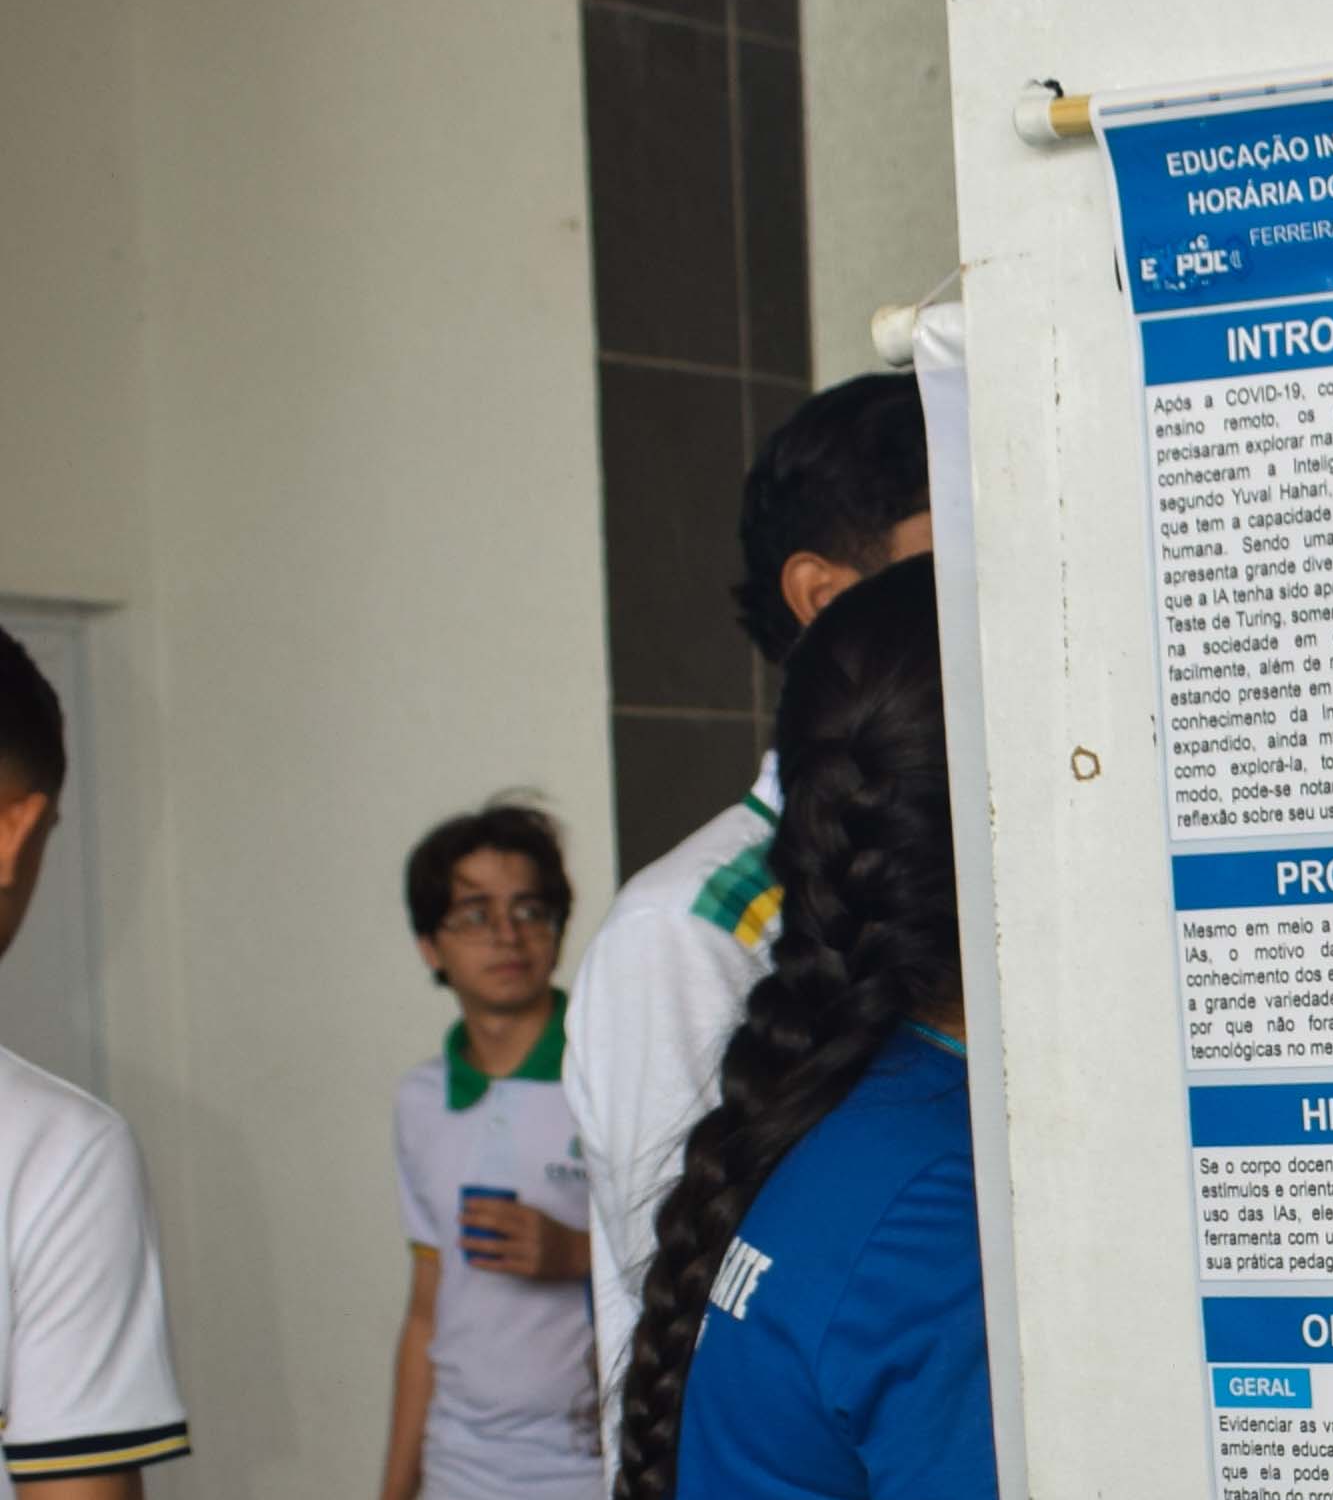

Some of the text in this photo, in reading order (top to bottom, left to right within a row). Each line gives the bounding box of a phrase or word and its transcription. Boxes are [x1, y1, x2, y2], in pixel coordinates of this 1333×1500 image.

[1166, 134, 1309, 177] EDUCAÇÃO
[1188, 179, 1304, 216] HORÁRIA
[1229, 1376, 1296, 1397] GERAL
